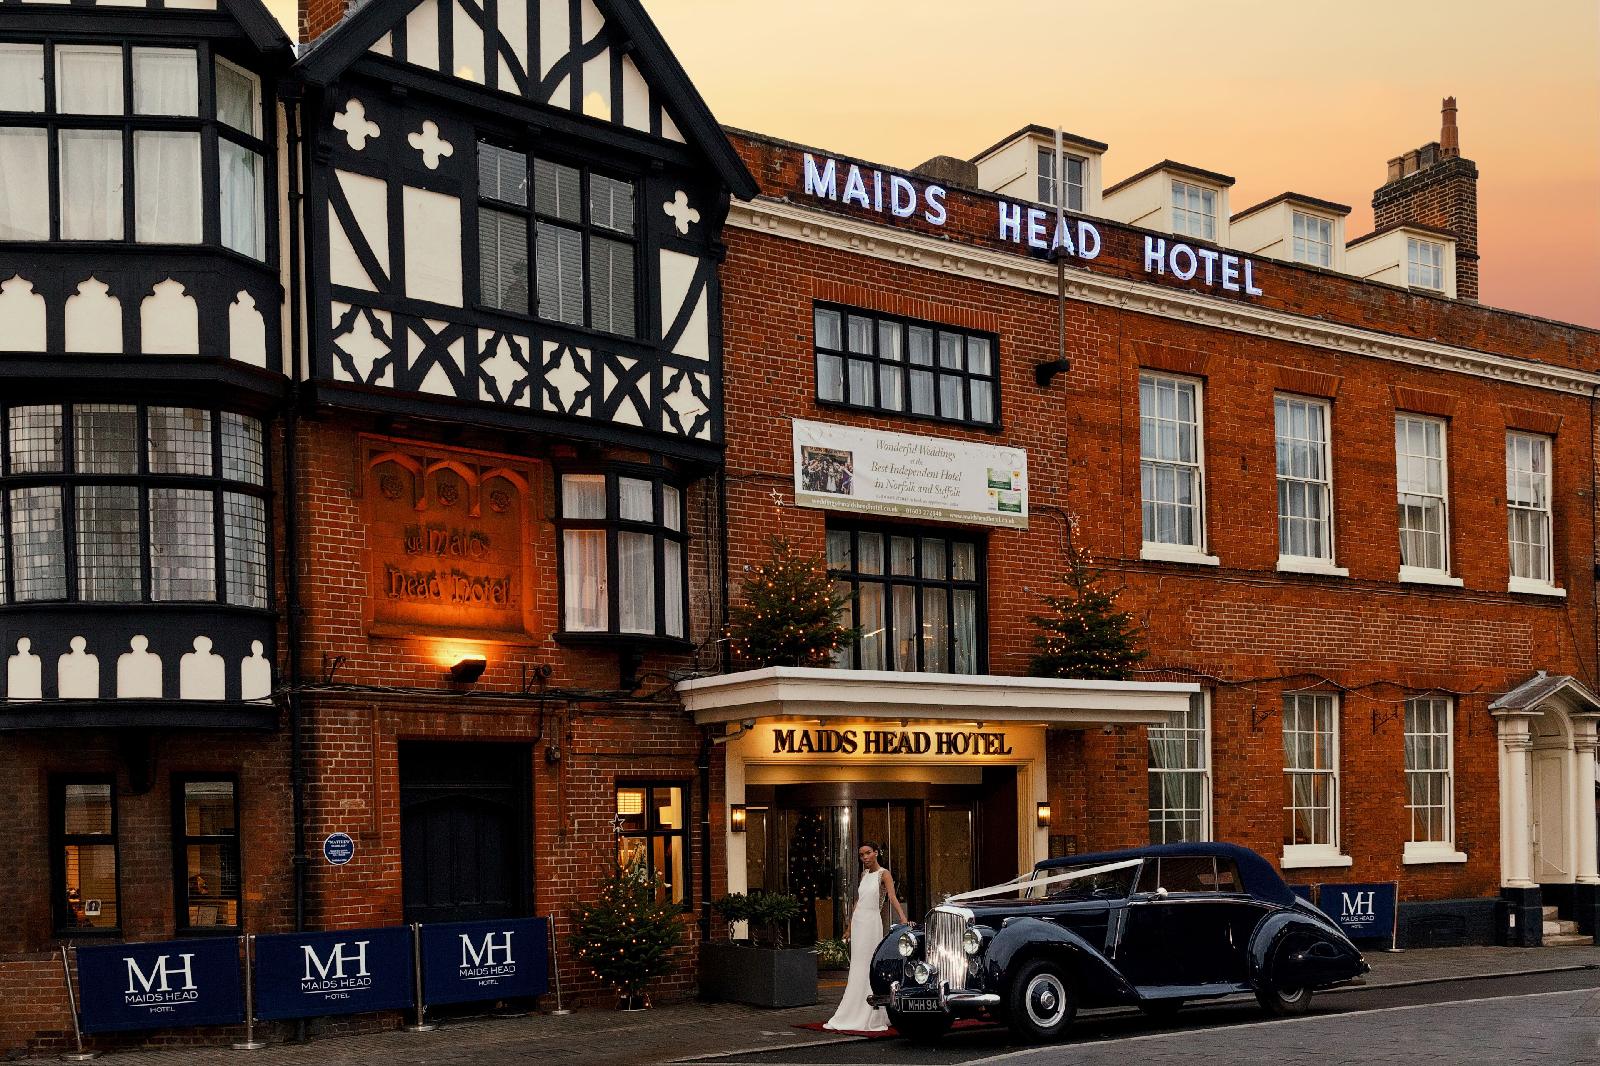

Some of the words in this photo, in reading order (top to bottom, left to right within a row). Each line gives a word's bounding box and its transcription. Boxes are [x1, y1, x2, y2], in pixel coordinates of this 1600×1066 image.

[803, 152, 948, 226] MAIDS
[998, 200, 1101, 260] HEAD
[1144, 235, 1264, 297] HOTEL
[876, 439, 918, 456] Wonderful
[920, 445, 956, 461] Weddings
[871, 461, 888, 473] Best
[889, 463, 939, 479] Independent
[940, 470, 962, 481] Hotel
[874, 478, 884, 489] in
[885, 479, 915, 493] Norfolk
[917, 484, 933, 494] and
[934, 485, 961, 499] Suffolk
[773, 729, 858, 754] MAIDS
[863, 730, 931, 755] HEAD
[935, 732, 1012, 755] HOTEL
[1341, 891, 1375, 915] MH
[459, 931, 515, 967] MH
[300, 941, 371, 981] MH
[460, 967, 489, 977] MAIDS
[490, 965, 515, 975] HEAD
[123, 953, 198, 994] MH
[301, 979, 338, 991] MAIDS
[340, 977, 371, 988] HEAD
[125, 993, 163, 1004] MAIDS
[166, 990, 199, 1001] HEAD
[908, 999, 925, 1010] MHH
[926, 1000, 938, 1010] 94
